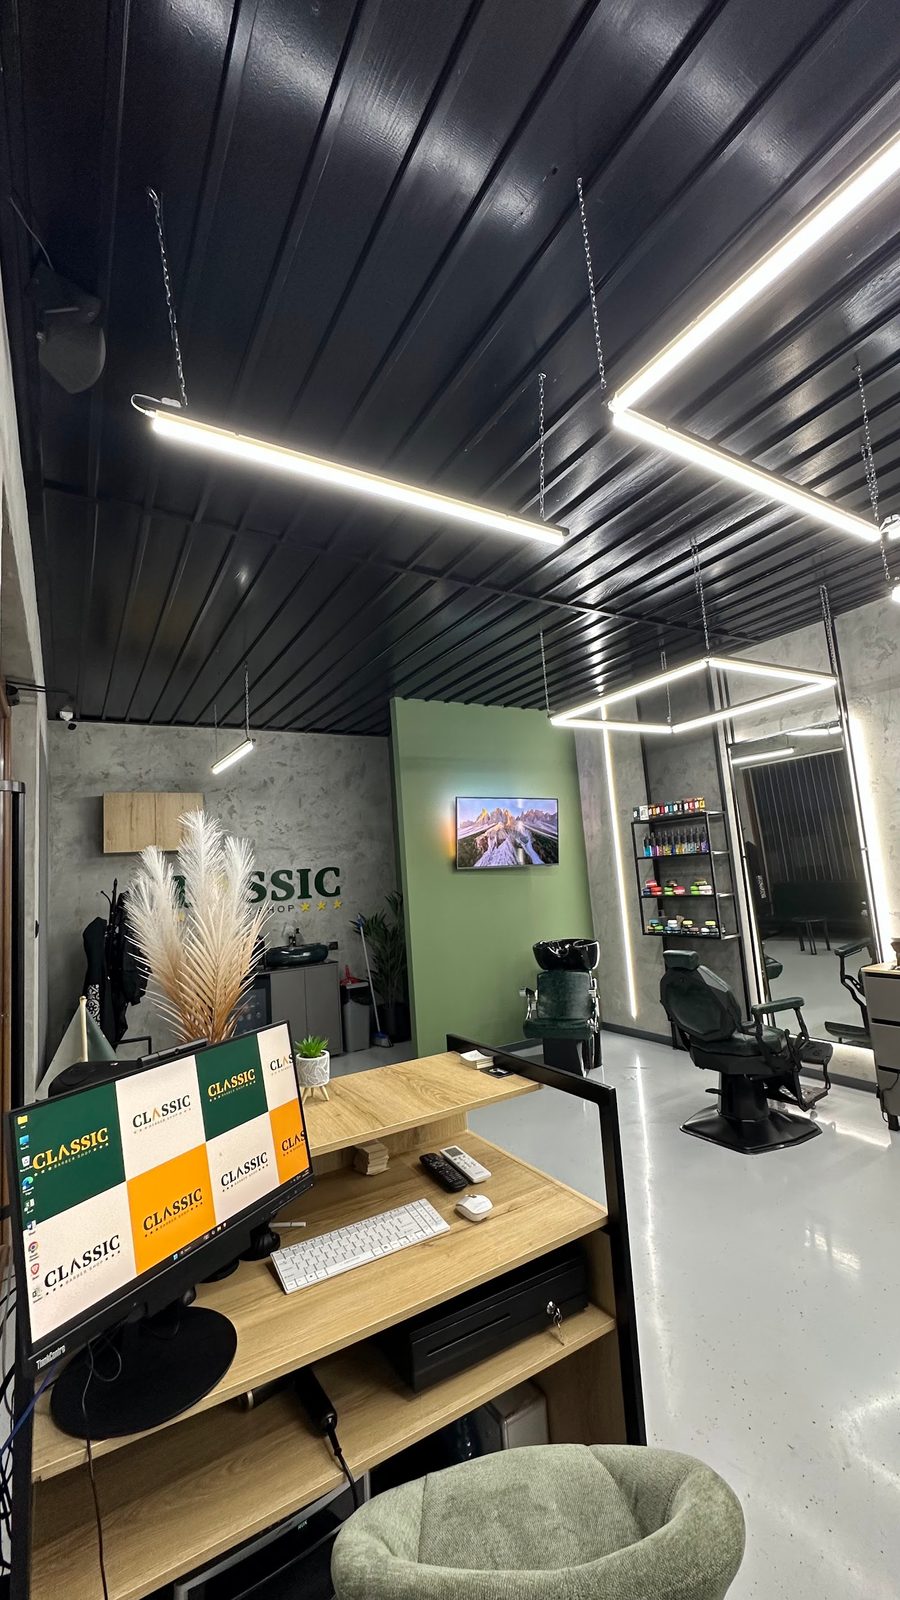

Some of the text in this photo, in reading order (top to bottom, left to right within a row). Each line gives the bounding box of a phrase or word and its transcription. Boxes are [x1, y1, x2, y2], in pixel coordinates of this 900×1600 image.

[207, 1068, 256, 1097] CLASSIC
[132, 1094, 191, 1128] CLASSIC
[32, 1127, 109, 1170] CLASSIC
[221, 1151, 268, 1187] CLASSIC
[143, 1188, 203, 1231] CLASSIC
[44, 1234, 120, 1288] CLASSIC
